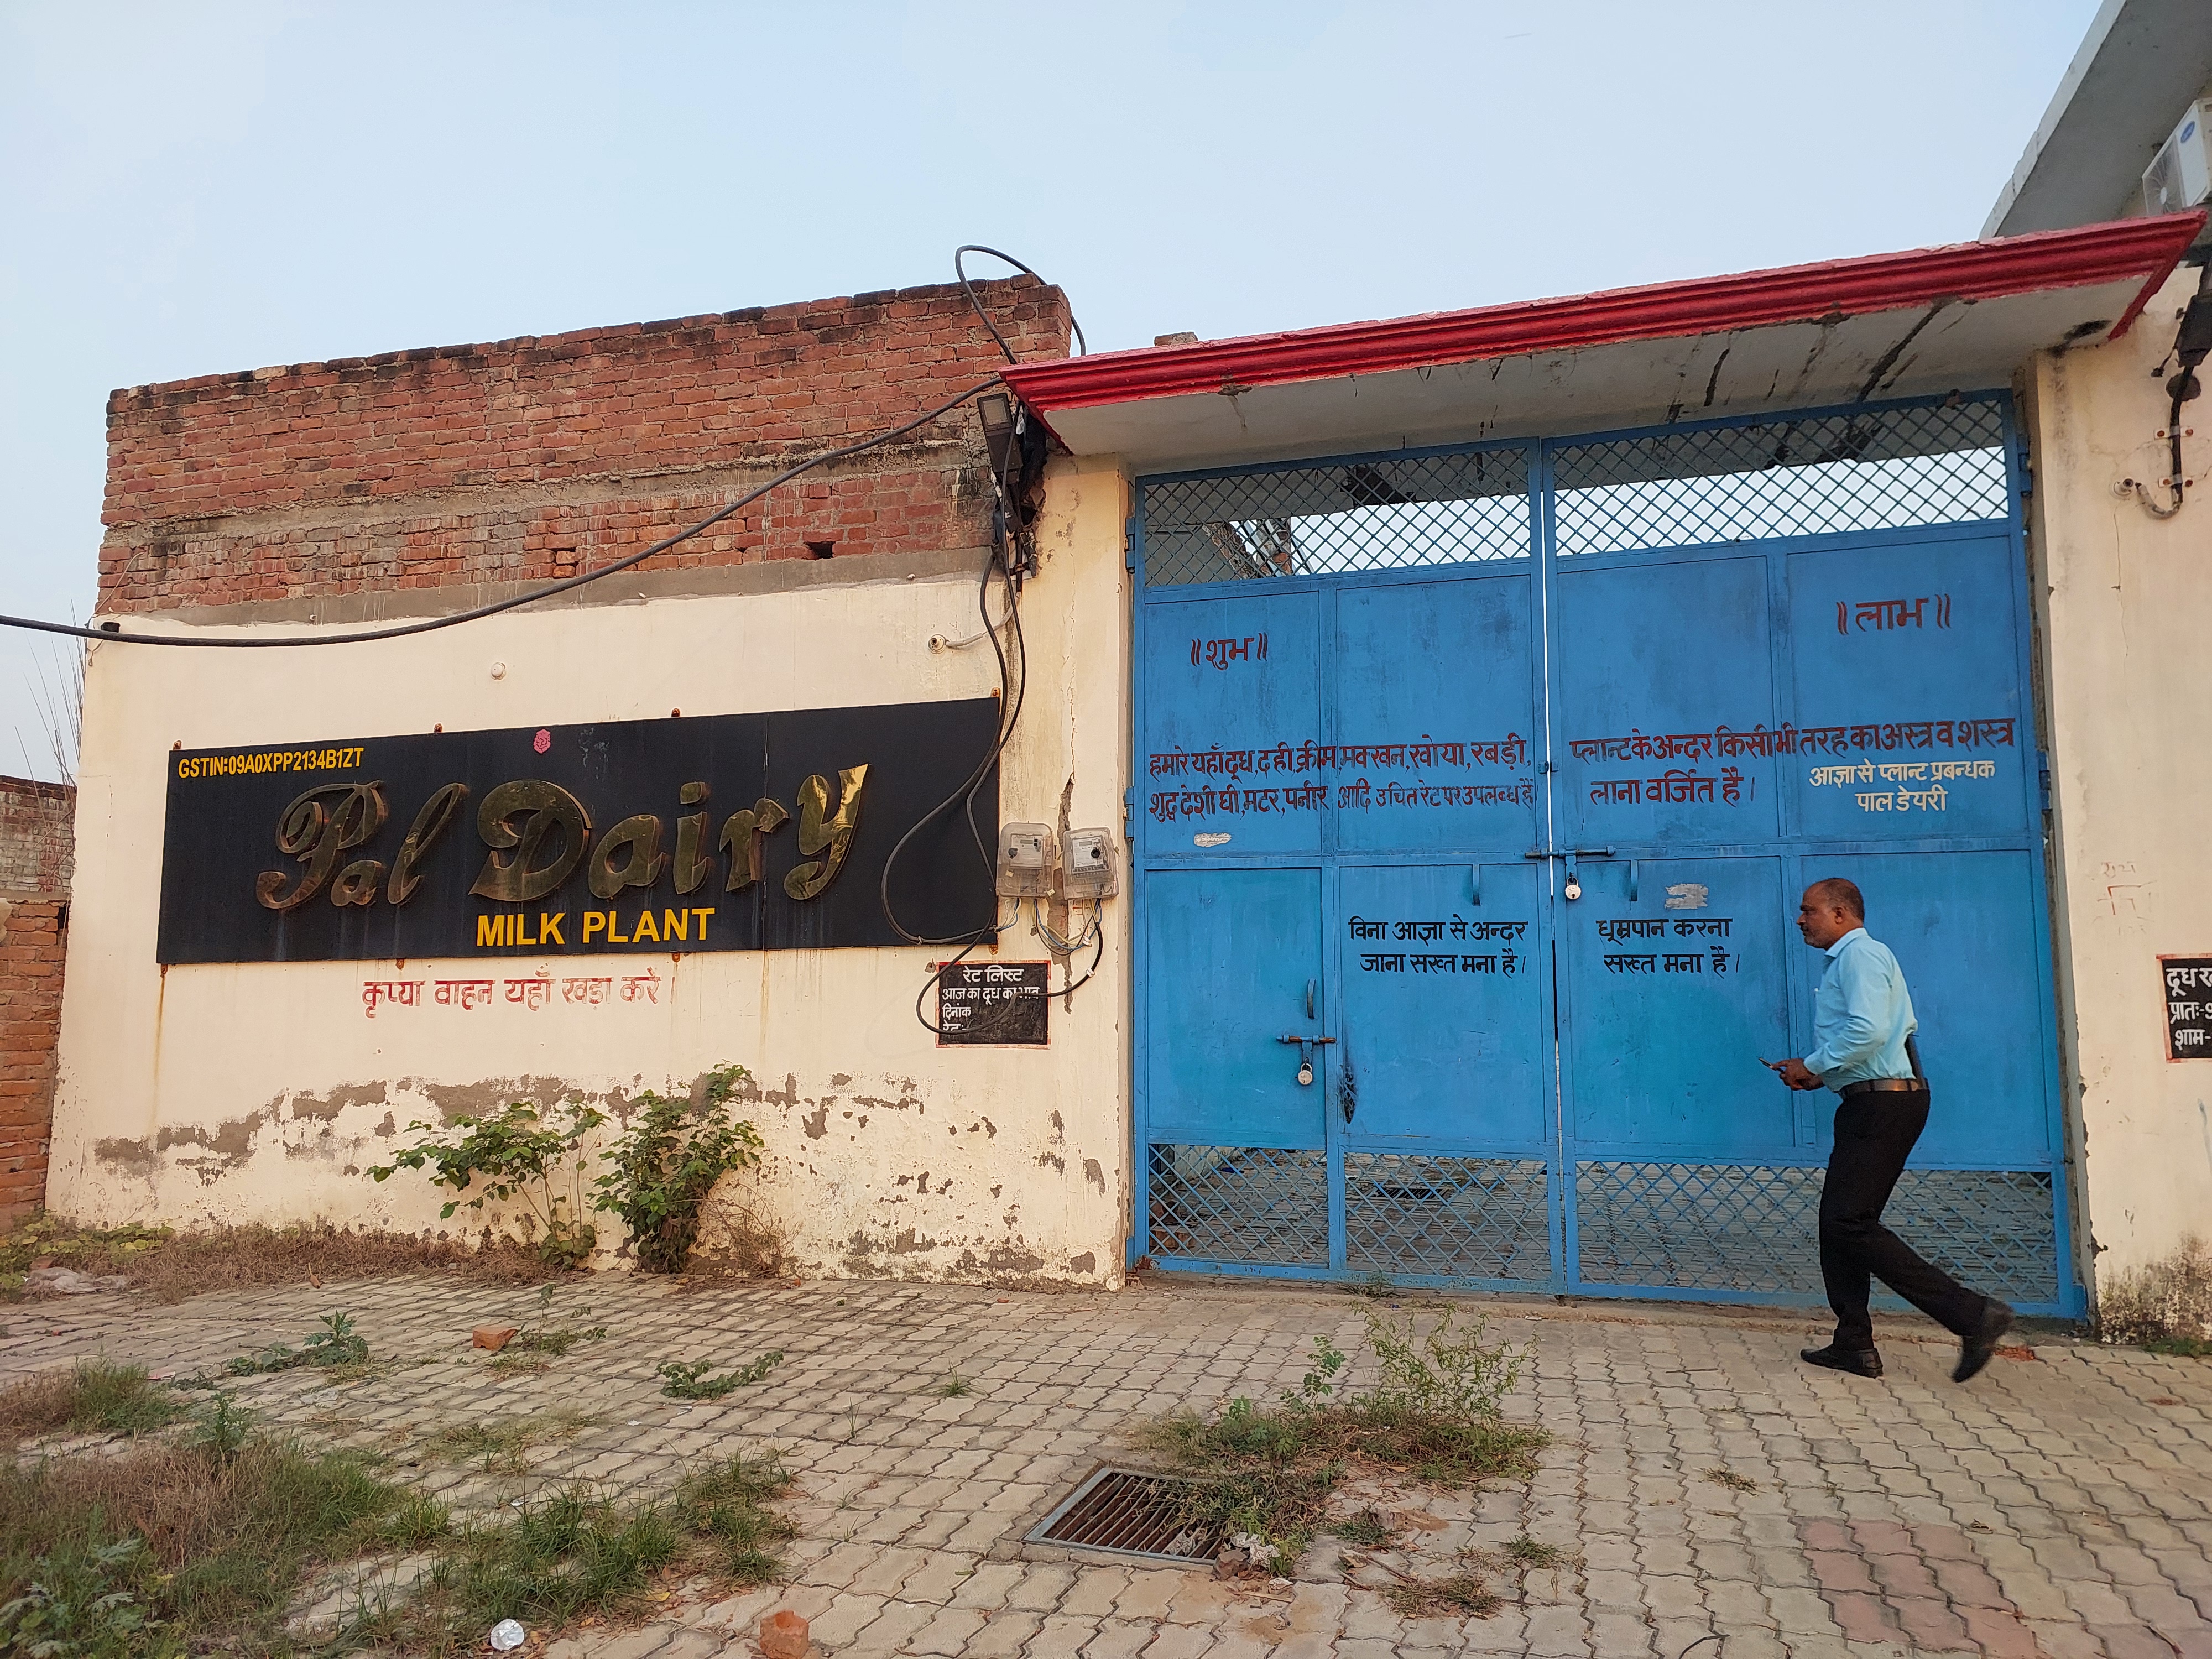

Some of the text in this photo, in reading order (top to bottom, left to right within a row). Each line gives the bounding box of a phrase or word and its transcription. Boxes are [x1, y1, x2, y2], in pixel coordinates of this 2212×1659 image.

[1631, 728, 1652, 760] के
[1652, 733, 1713, 764] अन्दर
[1715, 724, 1775, 759] किसी
[1774, 722, 1799, 755] भी
[1799, 726, 1849, 759] तरह
[1850, 724, 1881, 751] का
[1880, 722, 1934, 750] अस्त्र
[1936, 721, 1955, 748] व
[1957, 718, 2016, 752] शस्त्र
[1149, 745, 1190, 782] हमारे
[1809, 758, 1996, 789] आज्ञा से प्लान्ट प्रबन्धक
[1180, 784, 1218, 822] देशी
[1282, 780, 1329, 810] पनीर
[1338, 778, 1371, 815] आदि
[1375, 781, 1419, 809] उचित
[1418, 779, 1442, 807] रेट
[1441, 786, 1463, 807] पर
[1590, 779, 1643, 806] लाना
[1646, 769, 1718, 804] वर्जित
[1854, 784, 1949, 812] पाल डेयरी
[255, 763, 871, 910] Pal Dairy
[476, 907, 716, 947] MILK PLANT
[1392, 921, 1446, 947] आज्ञा
[1449, 914, 1469, 941] से
[1469, 921, 1528, 946] अन्दर
[1673, 918, 1733, 938] करना
[963, 964, 1025, 983] रेट लिस्ट
[1360, 953, 1406, 974] जाना
[1410, 954, 1458, 974] सख्त
[1461, 954, 1497, 974] मना
[1603, 954, 1657, 975] सख्त
[1661, 953, 1705, 974] मना
[434, 979, 496, 1011] वाहन
[942, 988, 967, 1000] आज
[967, 988, 981, 1000] का
[982, 987, 1001, 1005] दूध
[2166, 968, 2198, 997] दूध
[942, 1003, 972, 1021] दिनांक
